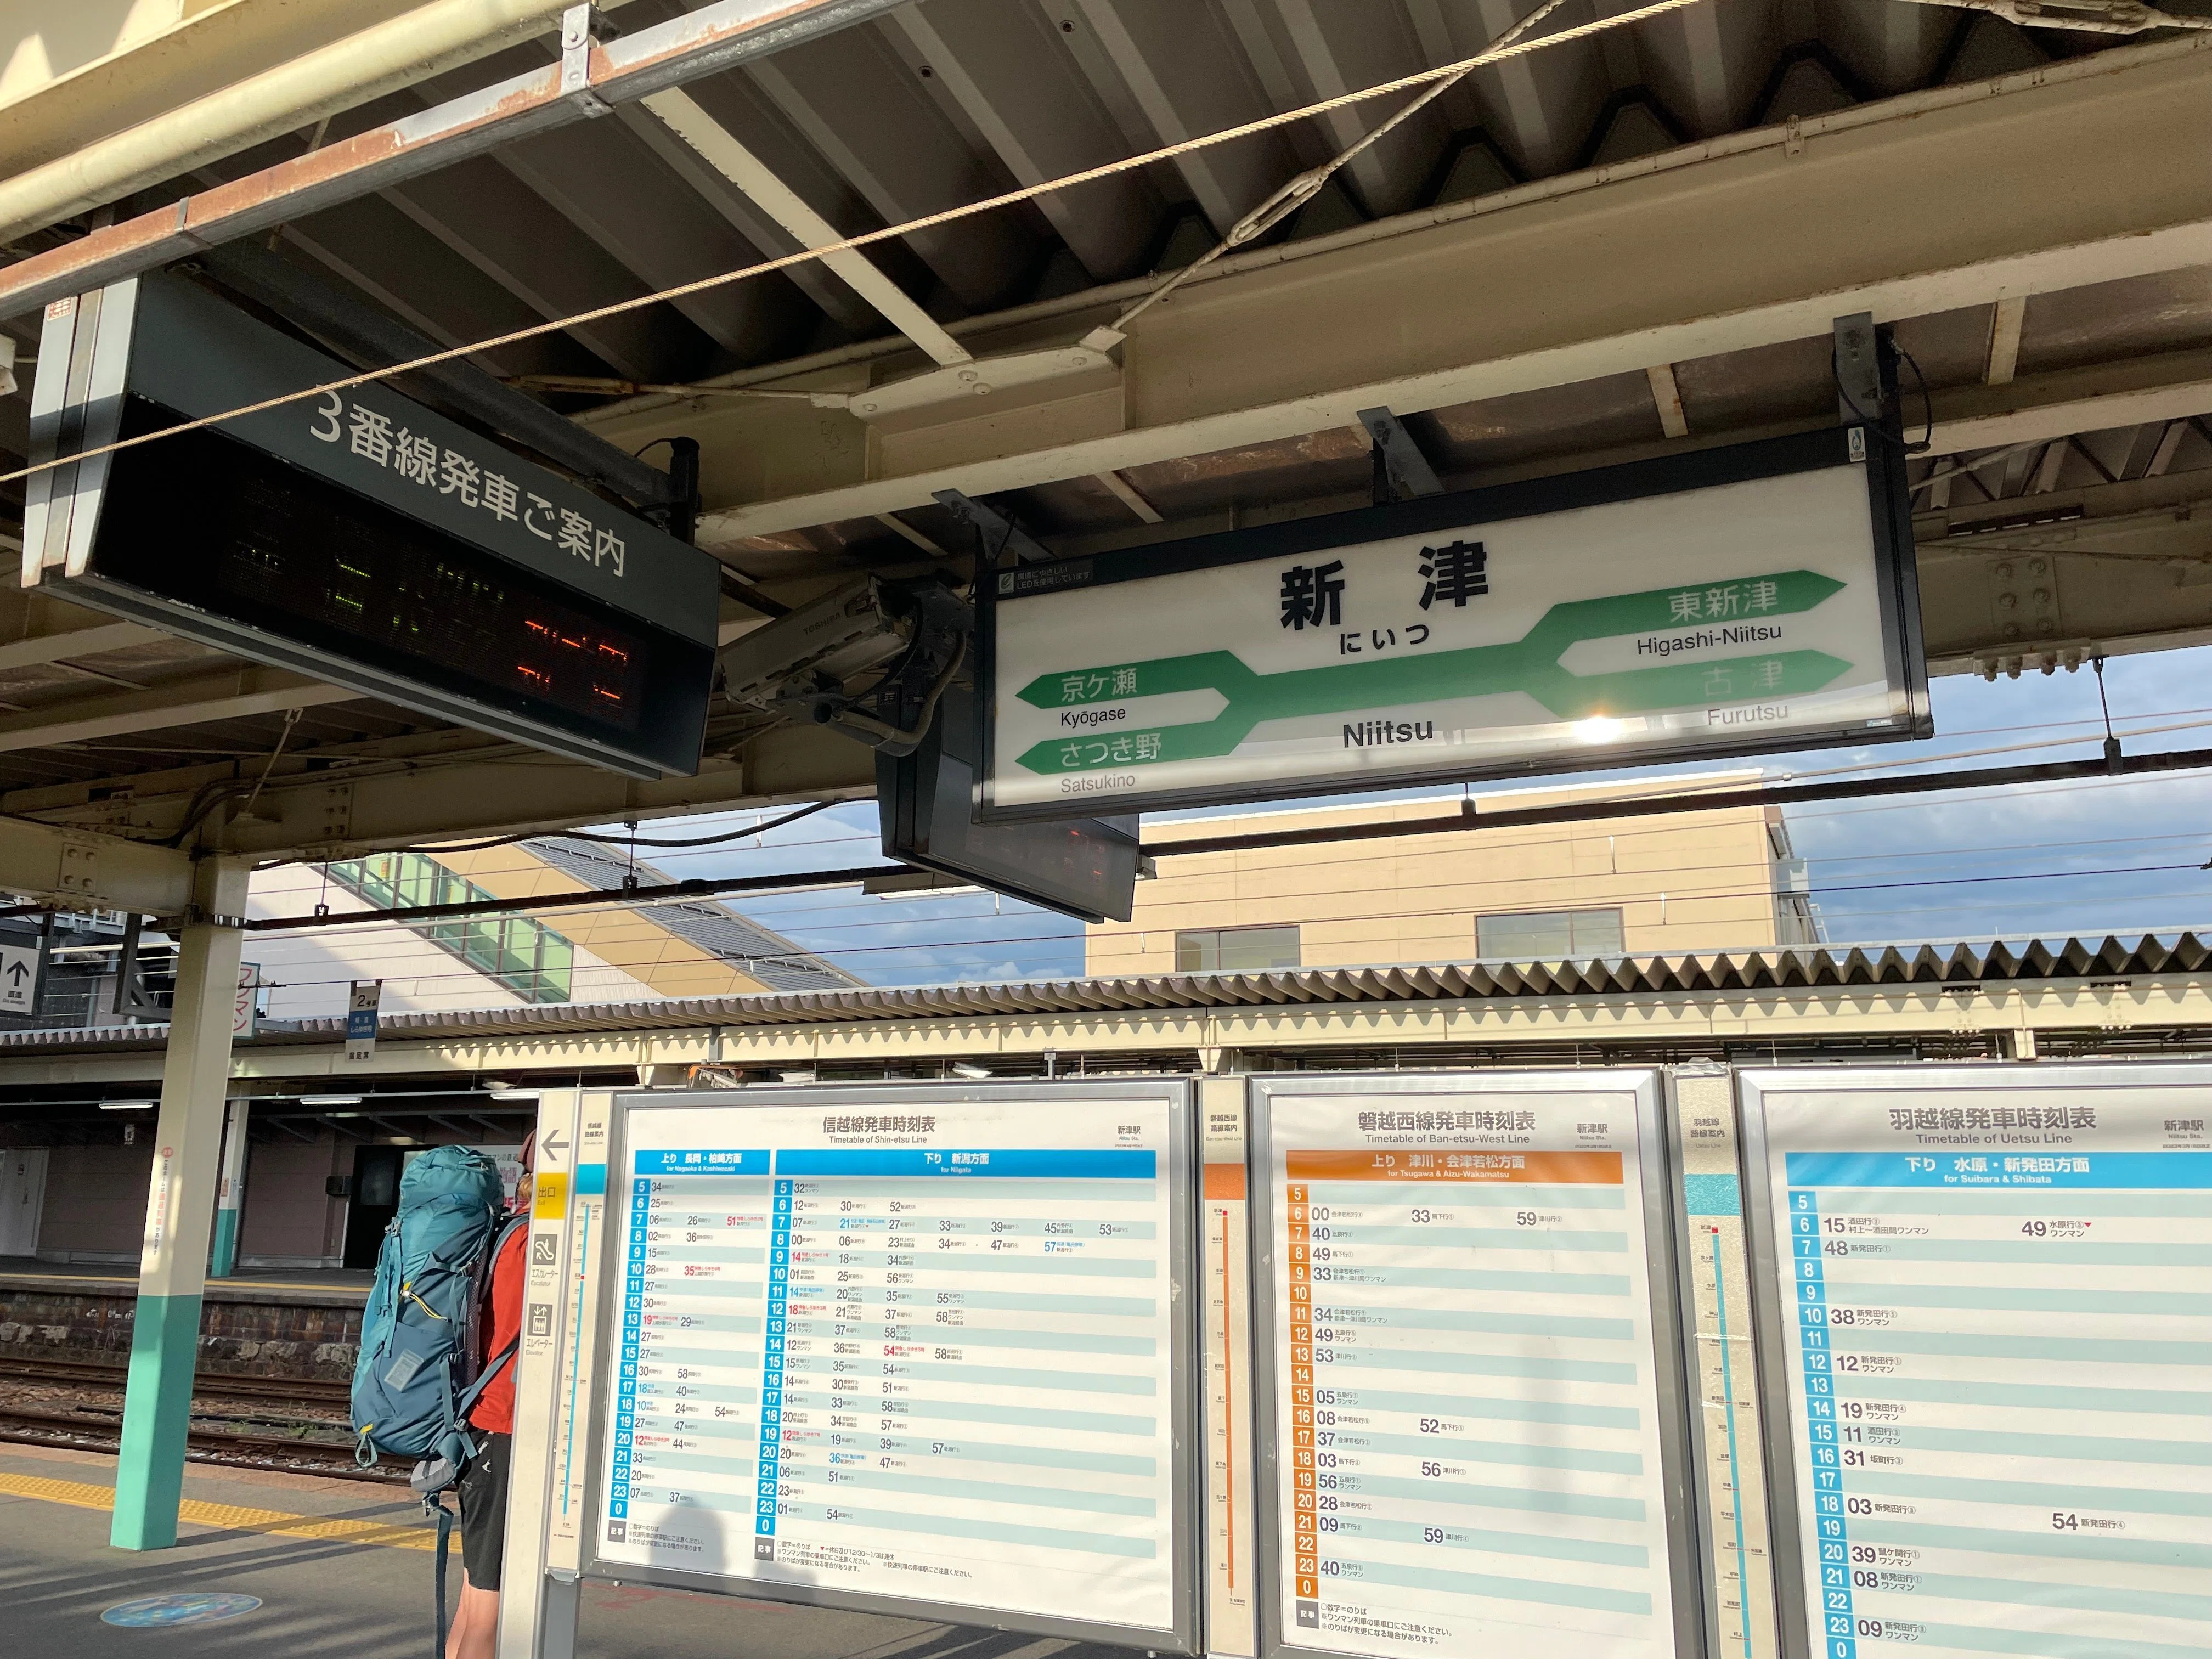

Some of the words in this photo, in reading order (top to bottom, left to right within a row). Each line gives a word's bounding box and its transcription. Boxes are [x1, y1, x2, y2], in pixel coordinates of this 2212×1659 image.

[309, 383, 625, 577] 3番線発車ご案内
[1017, 567, 1068, 580] 環境にやさしい
[1018, 572, 1089, 589] LEDを使用しています
[1280, 540, 1488, 630] 新津
[1668, 580, 1779, 623] 東新津
[1340, 624, 1429, 654] にいつ
[1638, 625, 1781, 657] Higashi-Niitsu
[1701, 660, 1784, 696] 古津
[1060, 708, 1126, 729] Kyōgase
[1707, 706, 1788, 725] Furutsu
[1344, 720, 1432, 748] Niitsu
[1060, 732, 1161, 767] さつき野
[1061, 774, 1135, 793] Satsukino
[823, 1115, 935, 1133] 信越線発車時刻表
[1358, 1111, 1535, 1131] 磐越西線発車時刻表
[1889, 1107, 2097, 1130] 羽越線発車時刻表
[2164, 1120, 2204, 1131] 新津駅
[1118, 1126, 1141, 1134] 新津駅
[1577, 1124, 1607, 1133] 新津駅
[1365, 1135, 1414, 1143] Timetable
[1417, 1135, 1426, 1143] of
[1430, 1135, 1505, 1143] Ban-etsu-West
[1508, 1135, 1530, 1143] Line
[1916, 1134, 1979, 1143] Timetable
[1984, 1134, 1996, 1143] of
[2001, 1133, 2039, 1143] Uetsu
[2044, 1133, 2072, 1143] Line
[661, 1153, 676, 1163] 上り
[685, 1153, 742, 1164] 長岡・柏崎方面
[924, 1153, 941, 1164] 下り
[952, 1153, 989, 1164] 新潟方面
[1372, 1154, 1395, 1167] 上り
[1409, 1155, 1525, 1169] 津川・会津若松方面
[1905, 1158, 1936, 1172] 下り
[1954, 1157, 2089, 1172] 水原・新発田方面
[538, 1187, 555, 1197] 出口
[794, 1183, 804, 1193] 32
[1295, 1187, 1301, 1200] 5
[1799, 1195, 1808, 1209] 5
[1295, 1207, 1302, 1220] 6
[1312, 1207, 1329, 1221] 00
[1412, 1210, 1430, 1223] 33
[1517, 1212, 1536, 1226] 59
[840, 1218, 849, 1228] 21
[889, 1220, 900, 1229] 27
[939, 1221, 951, 1231] 33
[991, 1222, 1003, 1232] 39
[1045, 1223, 1056, 1233] 45
[1099, 1224, 1111, 1235] 53
[1296, 1227, 1302, 1240] 7
[1313, 1227, 1330, 1240] 40
[1801, 1217, 1809, 1232] 6
[1824, 1218, 1845, 1232] 15
[2022, 1221, 2046, 1236] 49
[939, 1238, 950, 1249] 34
[991, 1240, 1002, 1250] 47
[1045, 1242, 1056, 1252] 57
[1802, 1240, 1810, 1254] 7
[1825, 1241, 1848, 1255] 48
[1296, 1246, 1302, 1260] 8
[1313, 1248, 1330, 1260] 49
[532, 1269, 558, 1278] エスカレーター
[1296, 1267, 1304, 1279] 9
[1313, 1267, 1331, 1280] 33
[1804, 1262, 1814, 1277] 8
[1294, 1286, 1307, 1300] 10
[1807, 1285, 1815, 1300] 9
[1314, 1308, 1333, 1321] 34
[1805, 1308, 1821, 1323] 10
[1831, 1309, 1854, 1324] 38
[1315, 1328, 1333, 1341] 49
[1808, 1331, 1821, 1346] 11
[527, 1339, 552, 1348] エレベーター
[1316, 1348, 1333, 1362] 53
[1837, 1356, 1858, 1371] 12
[1317, 1390, 1335, 1404] 05
[1841, 1402, 1862, 1418] 19
[1317, 1410, 1335, 1425] 08
[1420, 1419, 1439, 1433] 52
[1318, 1432, 1335, 1446] 37
[1844, 1426, 1861, 1442] 11
[1318, 1453, 1336, 1468] 03
[1421, 1462, 1441, 1477] 56
[1844, 1450, 1864, 1466] 31
[1319, 1474, 1337, 1488] 56
[1319, 1496, 1338, 1510] 28
[1848, 1498, 1872, 1514] 03
[2053, 1513, 2078, 1530] 54
[1320, 1517, 1338, 1532] 09
[1424, 1528, 1443, 1543] 59
[1852, 1546, 1876, 1563] 39
[1321, 1561, 1339, 1575] 40
[1854, 1571, 1878, 1588] 08
[1858, 1620, 1882, 1637] 09
